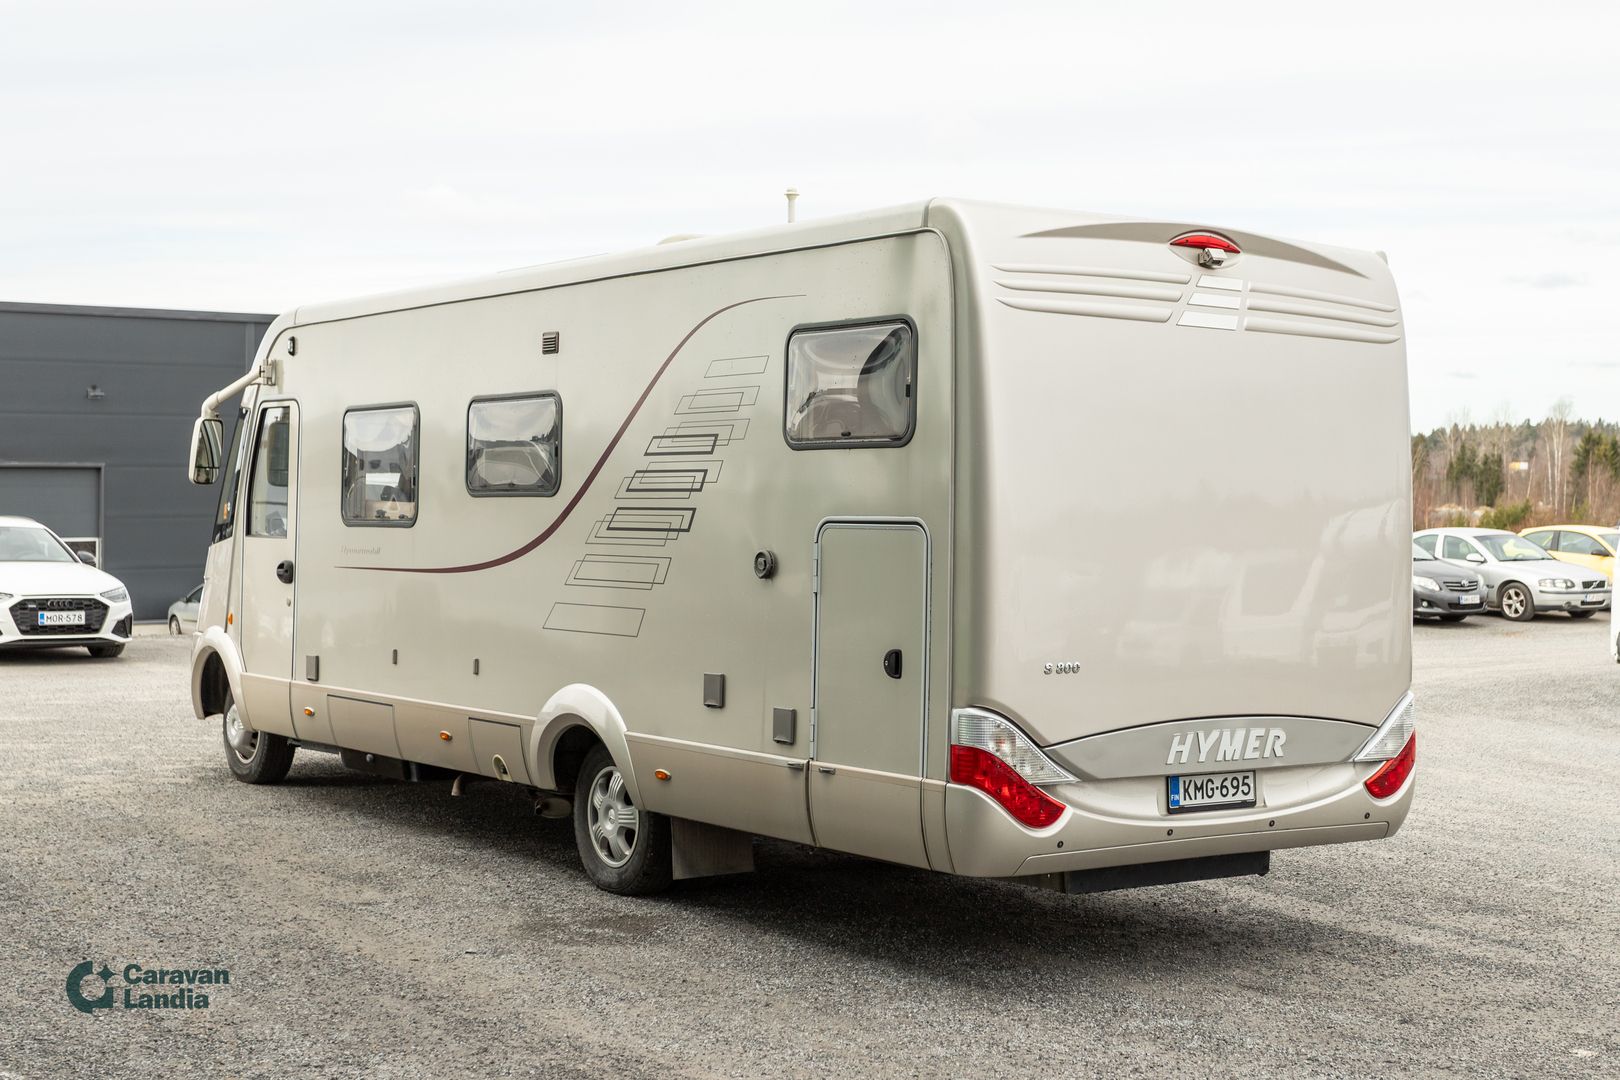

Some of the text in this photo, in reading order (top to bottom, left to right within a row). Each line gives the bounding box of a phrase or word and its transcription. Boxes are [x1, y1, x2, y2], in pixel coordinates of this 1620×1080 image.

[46, 613, 83, 623] MOR-578
[1043, 662, 1081, 676] S 800
[1166, 727, 1287, 765] HYMER
[1183, 775, 1252, 801] KMG-695
